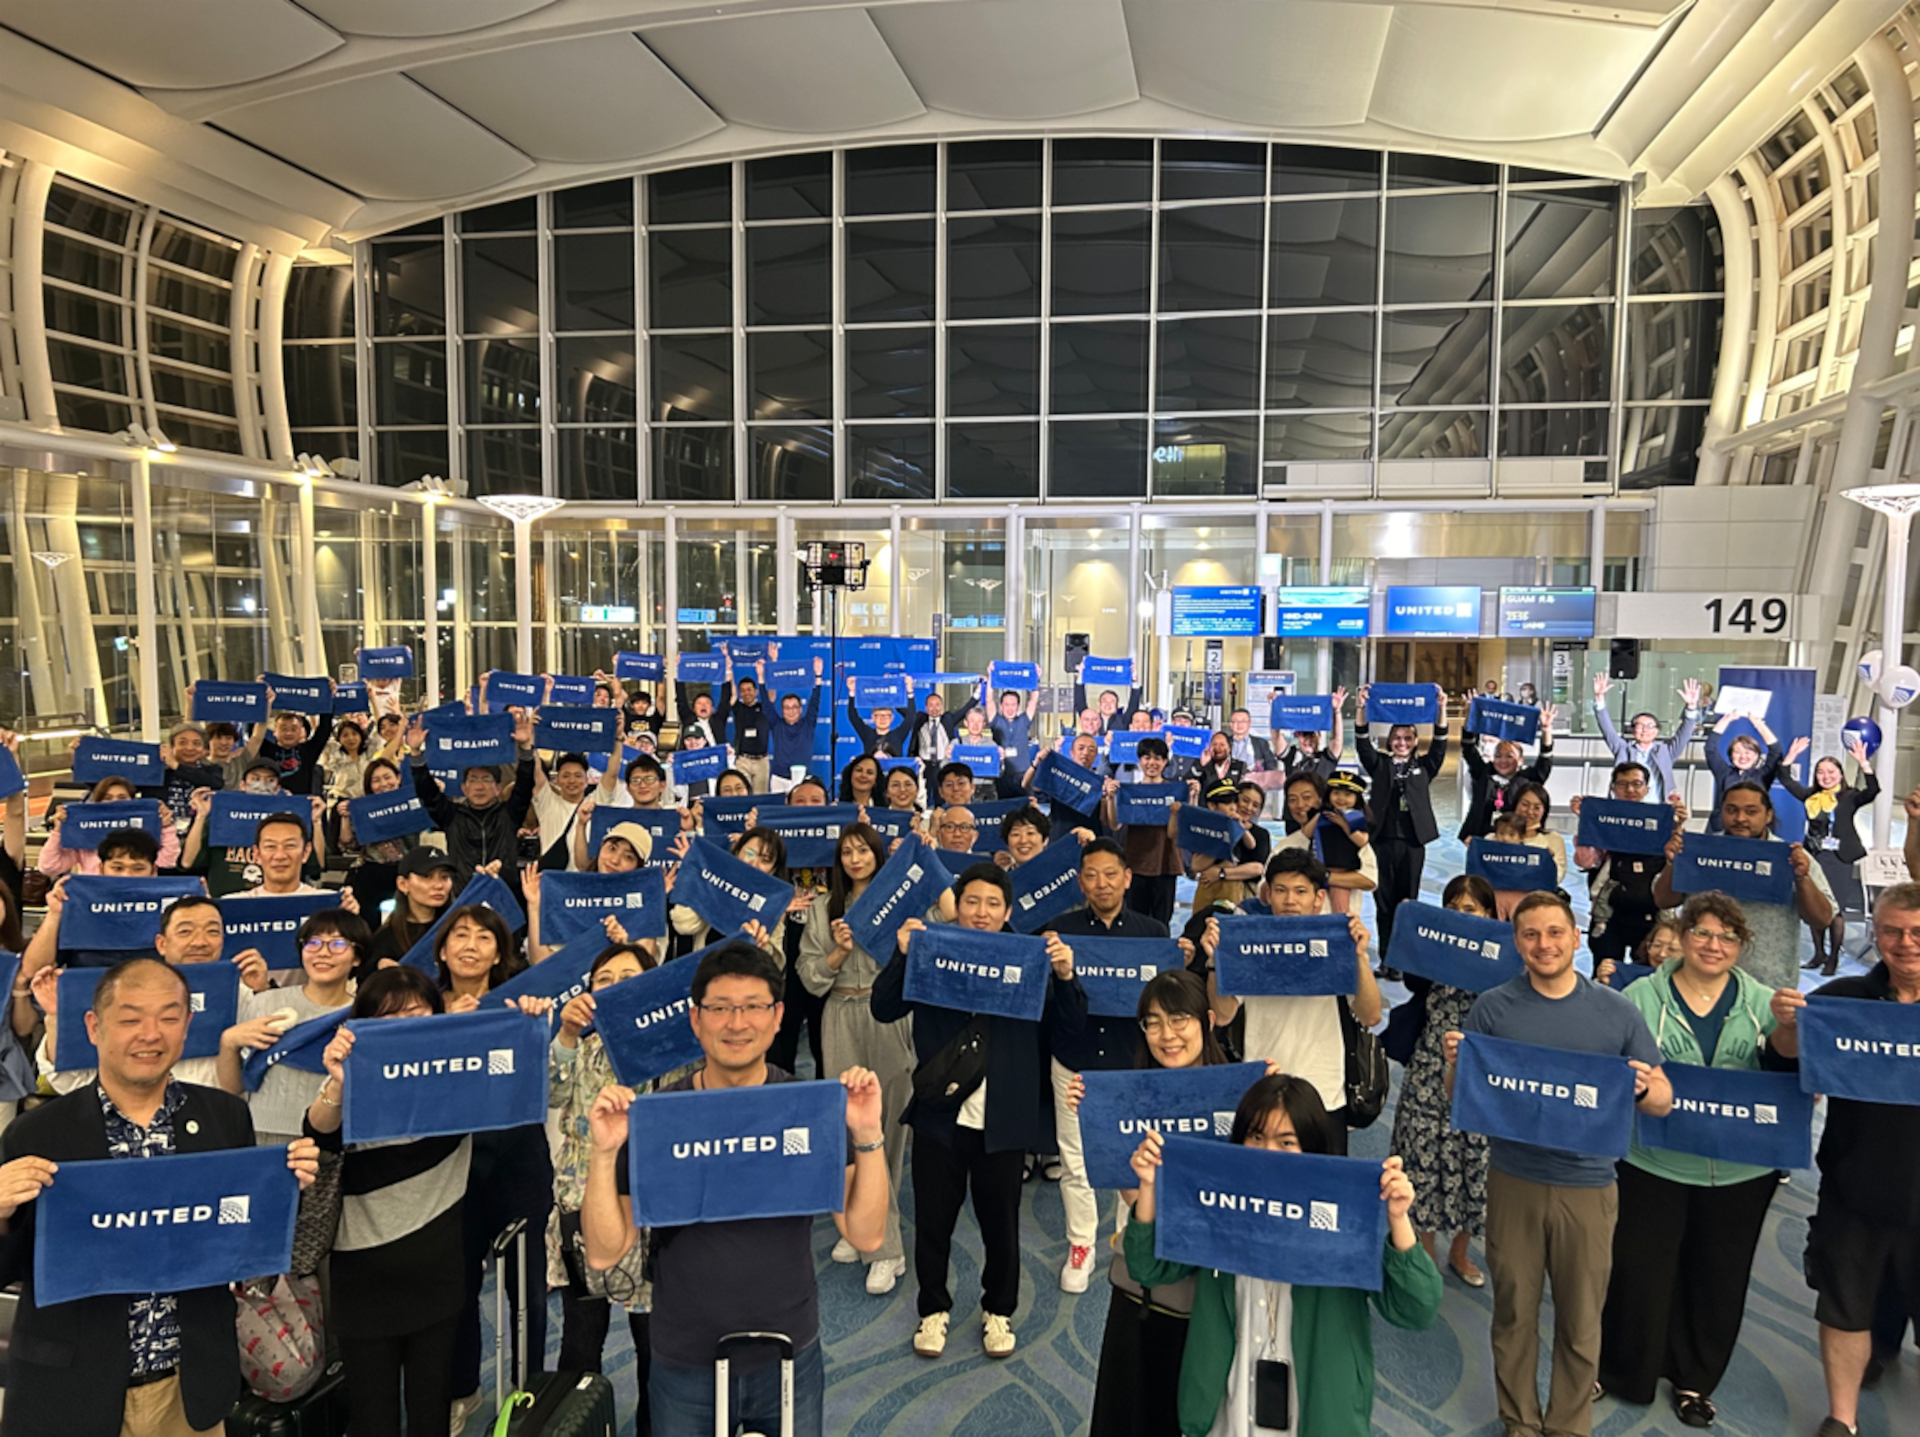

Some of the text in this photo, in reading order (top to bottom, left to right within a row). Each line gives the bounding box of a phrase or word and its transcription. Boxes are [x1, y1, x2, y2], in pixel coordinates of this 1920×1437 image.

[1395, 606, 1454, 616] UNITED
[1705, 598, 1786, 633] 149
[1211, 652, 1218, 661] 2
[1557, 654, 1564, 665] 3
[276, 688, 308, 696] UNITED
[499, 683, 526, 691] UNITED
[1482, 710, 1514, 722] UNITED
[552, 722, 590, 730] UNITED
[454, 739, 498, 748] UNITED
[92, 754, 135, 762] UNITED
[682, 758, 710, 768] UNITED
[1051, 768, 1080, 786] UNITED
[368, 804, 408, 818] UNITED
[80, 820, 128, 828] UNITED
[717, 814, 748, 822] UNIT
[1599, 816, 1643, 827] UNITED
[775, 828, 824, 837] UNITED
[1190, 826, 1223, 838] UNITED
[644, 860, 682, 868] UNIT
[1483, 854, 1526, 864] UNITED
[1698, 858, 1753, 870] UNITED
[702, 869, 750, 901] UNITED
[1034, 868, 1077, 899] UNITED
[92, 902, 158, 912] UNITED
[565, 897, 624, 907] UNITED
[872, 880, 912, 926] UNITED
[226, 921, 296, 934] UNITED
[1418, 927, 1479, 950] UNITED
[1240, 944, 1306, 954] UNITED
[936, 958, 1000, 978] UNITED
[1076, 966, 1137, 978] UNITED
[635, 996, 694, 1028] UNIT
[384, 1057, 482, 1079] UNITED
[1488, 1074, 1570, 1098] UNITED
[1672, 1097, 1750, 1118] UNITED
[1119, 1118, 1208, 1134] UNITED
[674, 1136, 776, 1158] UNITED
[1200, 1191, 1303, 1219] UNITED
[92, 1206, 212, 1228] UNITED
